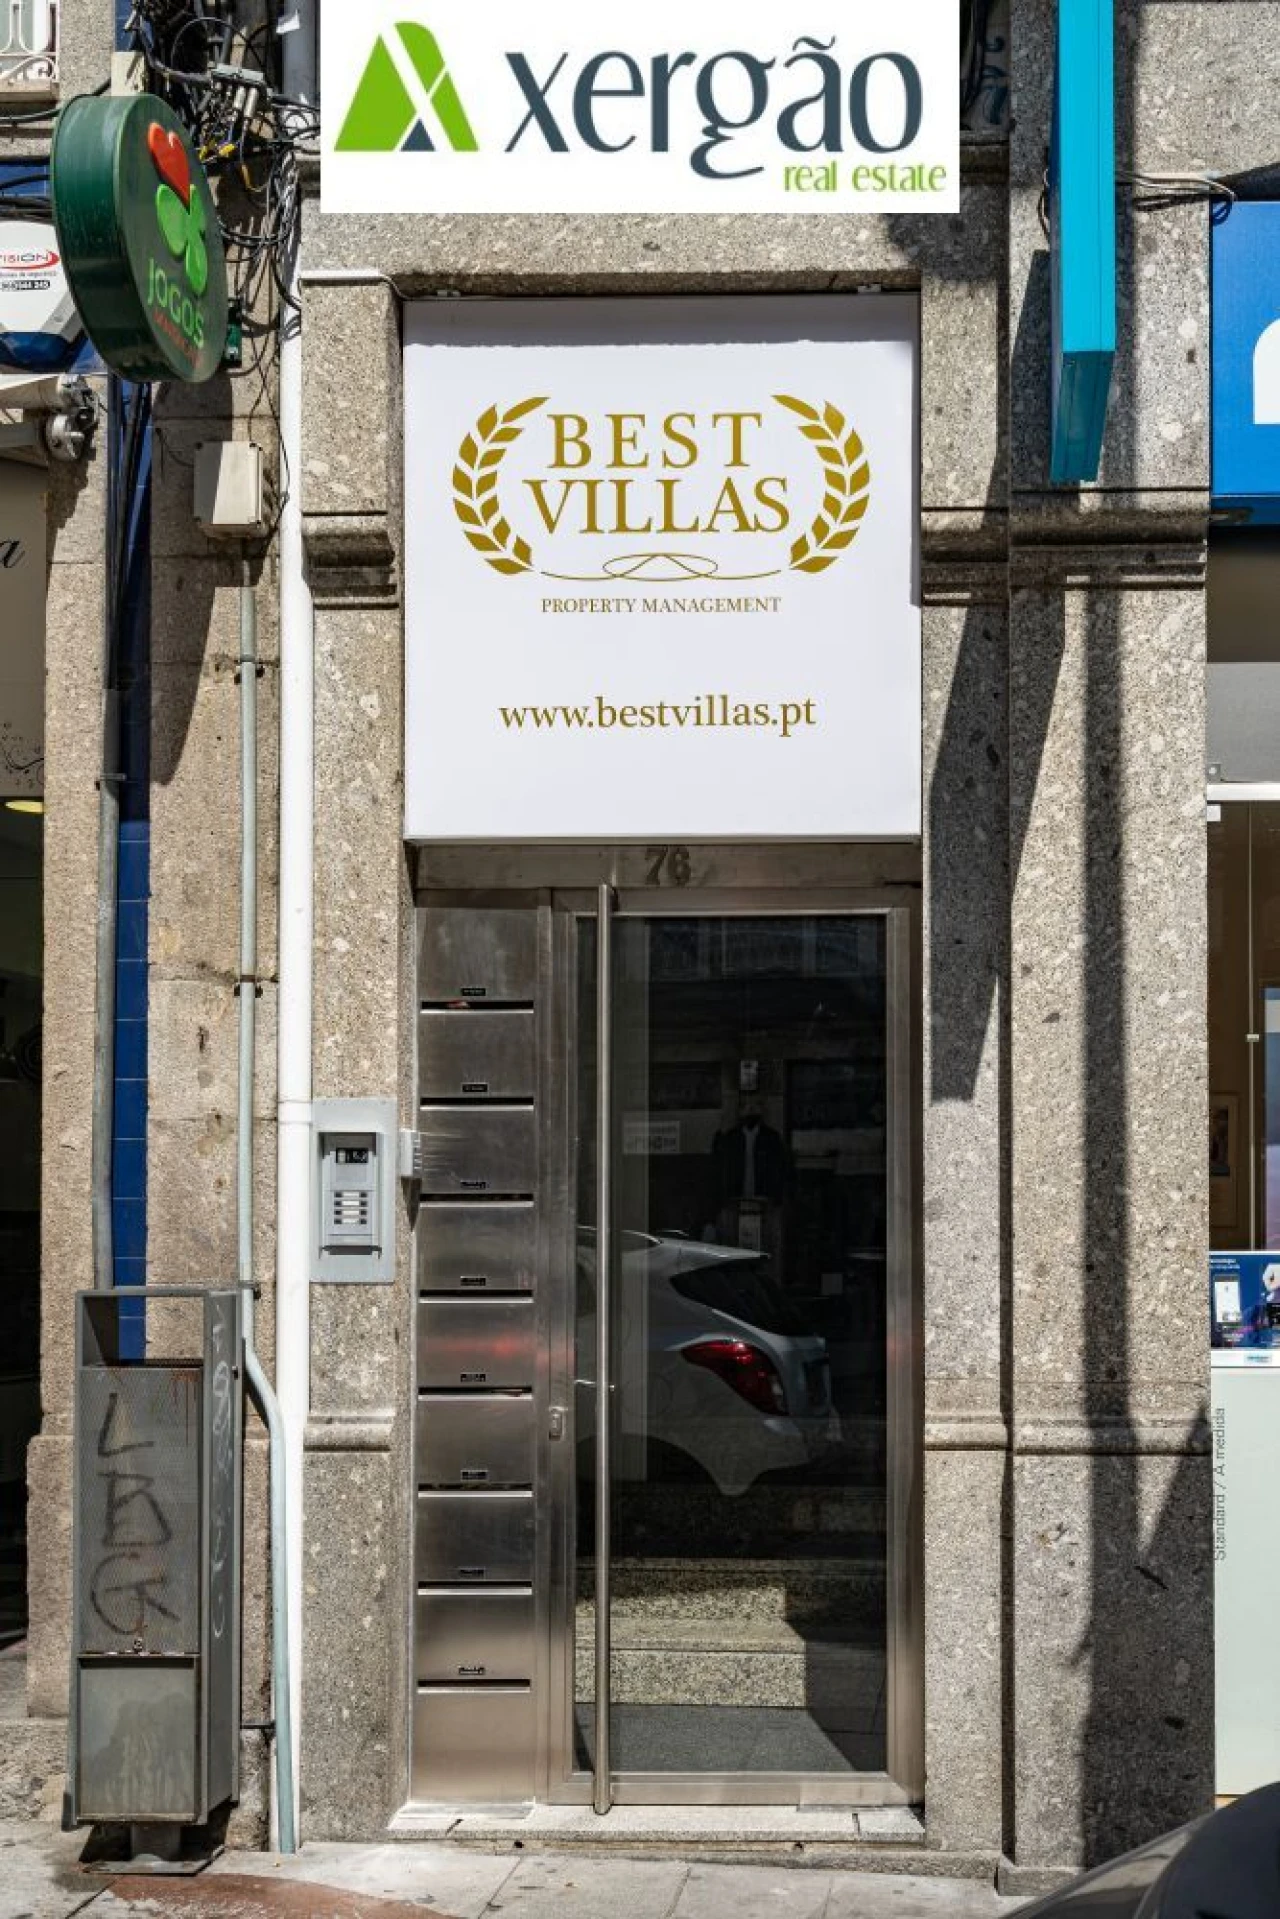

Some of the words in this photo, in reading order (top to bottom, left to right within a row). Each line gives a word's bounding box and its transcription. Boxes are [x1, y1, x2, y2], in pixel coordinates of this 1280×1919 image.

[147, 258, 204, 349] JOGOS
[547, 412, 763, 469] BEST
[522, 476, 790, 535] VILLAS
[541, 598, 635, 613] PROPERTY
[642, 597, 781, 613] MANAGEMENT
[498, 694, 816, 738] www.bestvillas.pt
[644, 847, 692, 887] 76
[1212, 1407, 1225, 1460] medida
[1213, 1494, 1226, 1561] Standard
